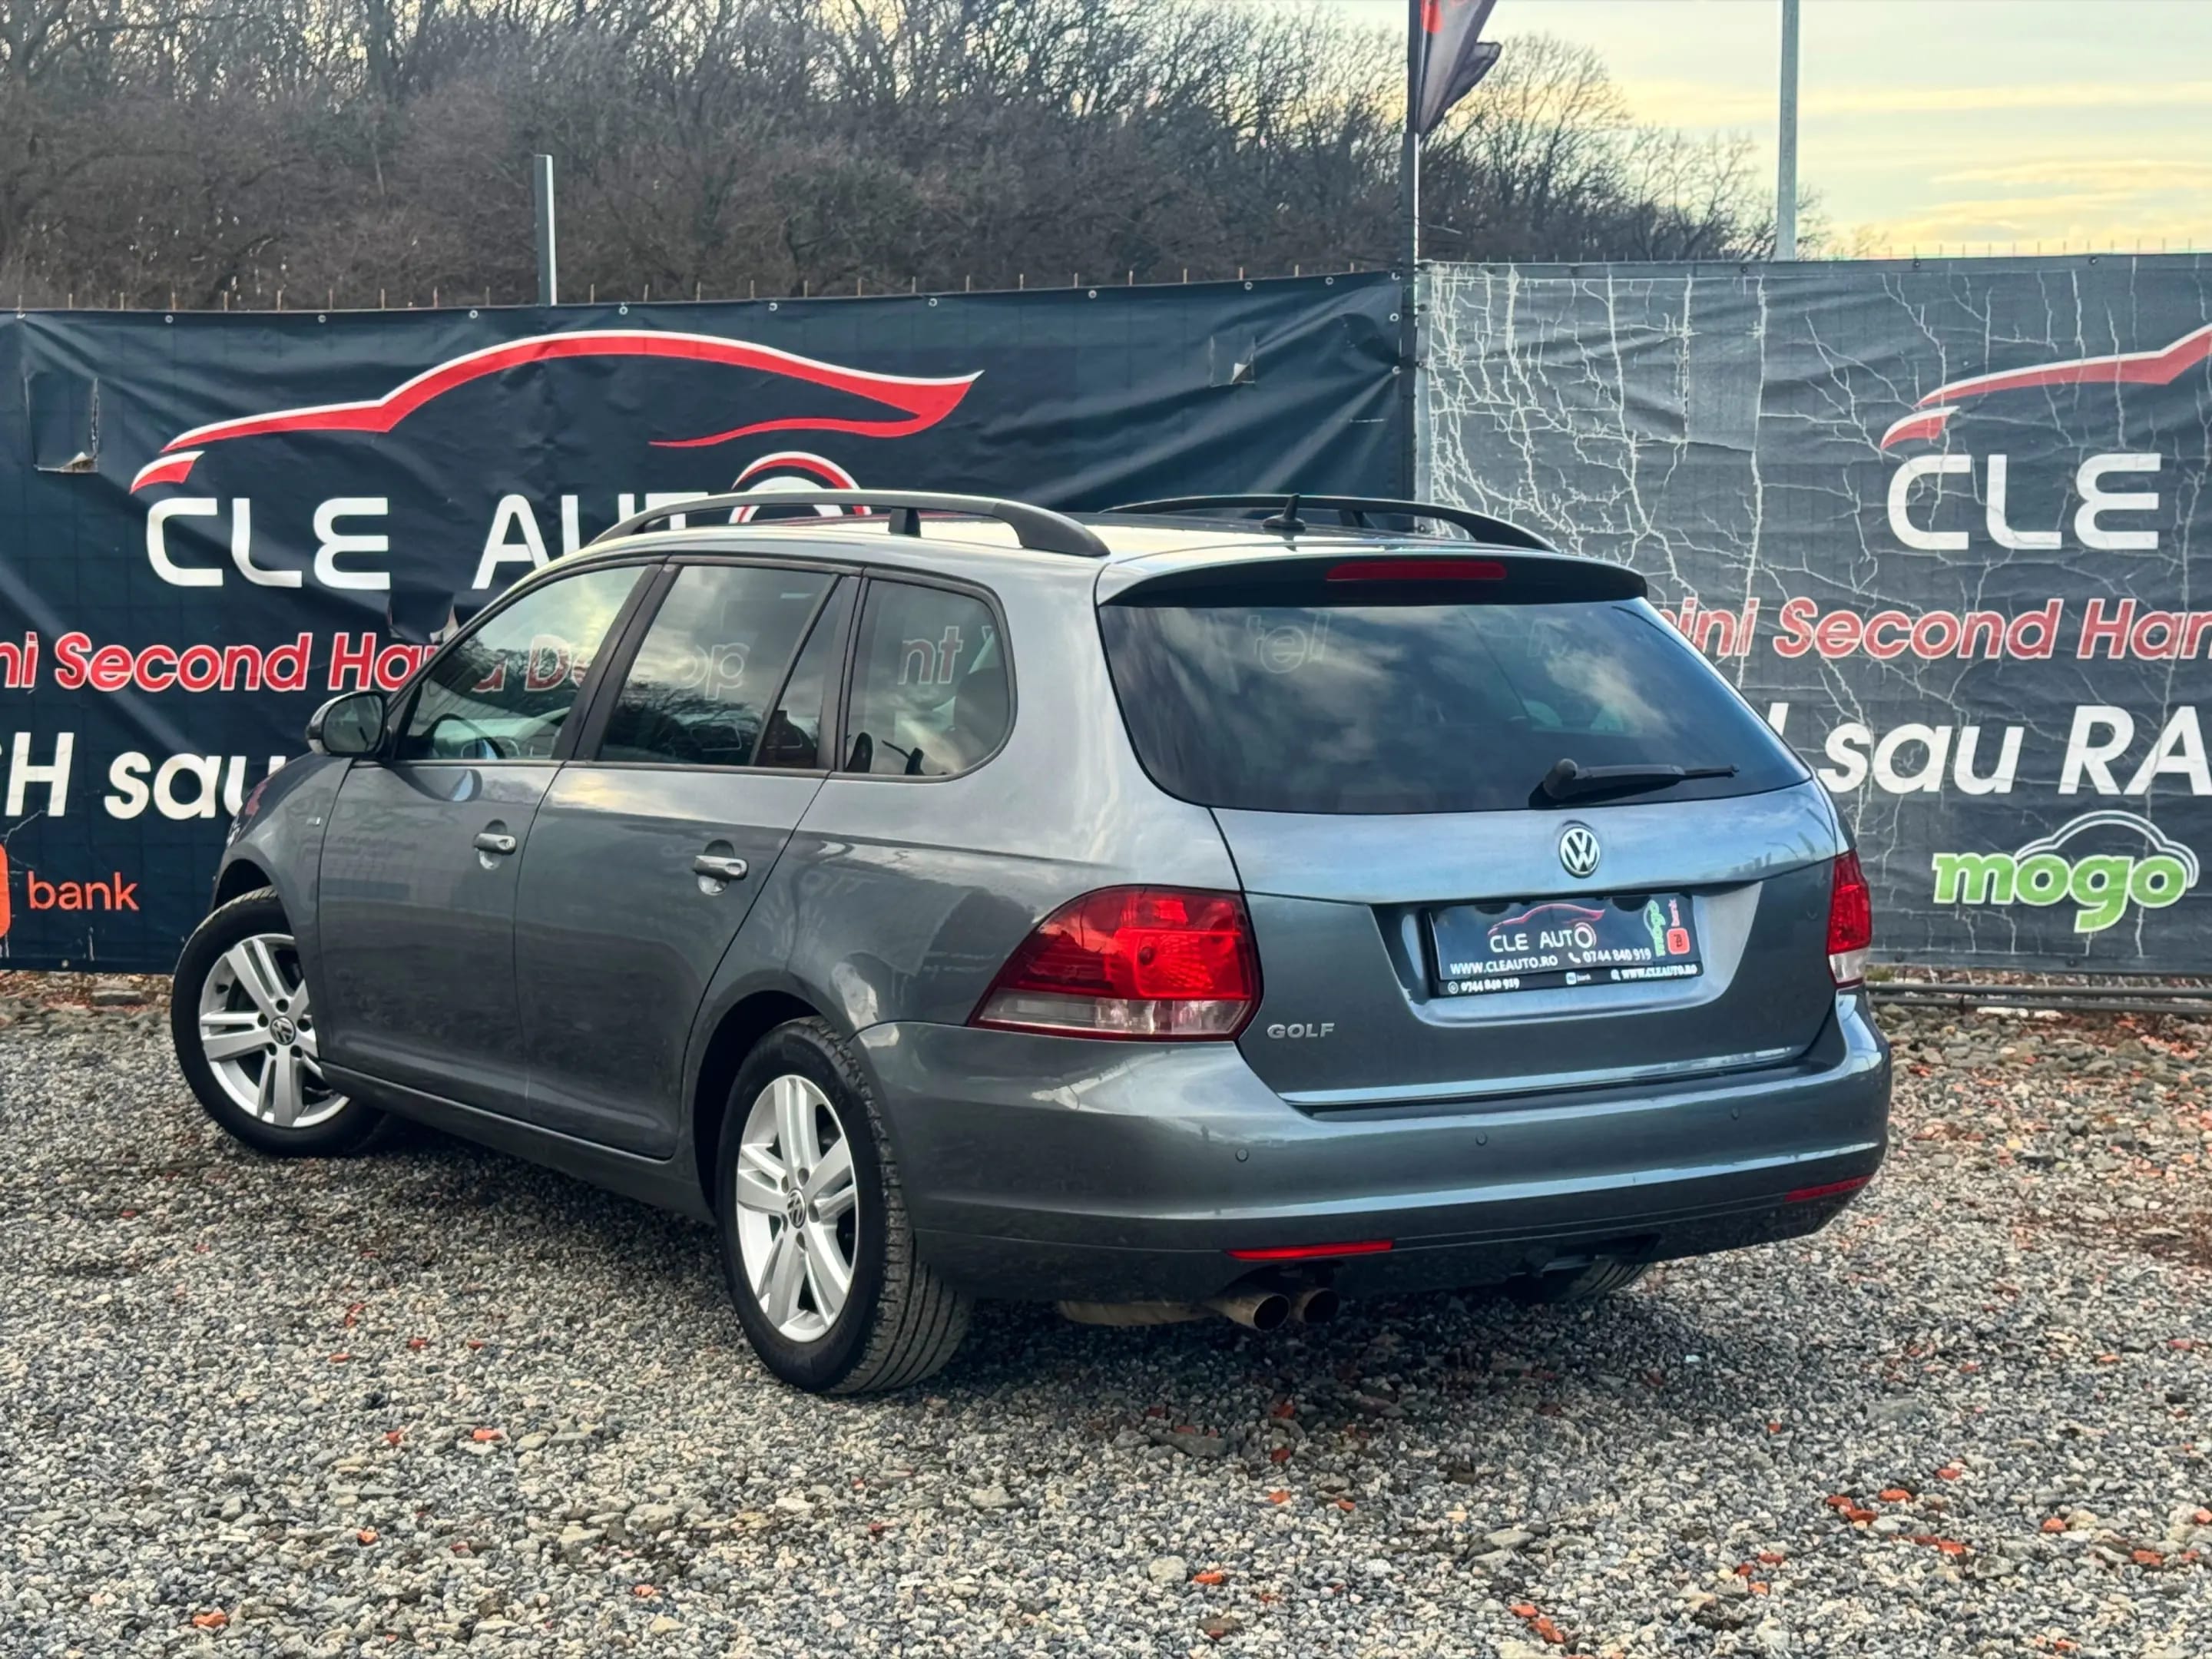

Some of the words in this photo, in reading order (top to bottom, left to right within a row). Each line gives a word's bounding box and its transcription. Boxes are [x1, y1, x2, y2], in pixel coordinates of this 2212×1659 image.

[1887, 453, 2161, 551] CLE
[146, 497, 390, 589] CLE
[1772, 596, 2064, 660] Second
[55, 631, 313, 692] Second
[5, 732, 75, 816] H
[104, 751, 286, 820] sau
[1816, 723, 2025, 796] sau
[2058, 705, 2212, 796] RA
[28, 870, 139, 911] bank
[1932, 851, 2188, 933] mogo
[1449, 955, 1558, 975] WWW.CLEAUTO.RO
[1582, 949, 1611, 964] 0744
[1612, 949, 1632, 962] 840
[1633, 948, 1651, 961] 919
[1489, 933, 1529, 953] CLE
[1539, 924, 1595, 949] AUTO
[1267, 1022, 1335, 1038] GOLF
